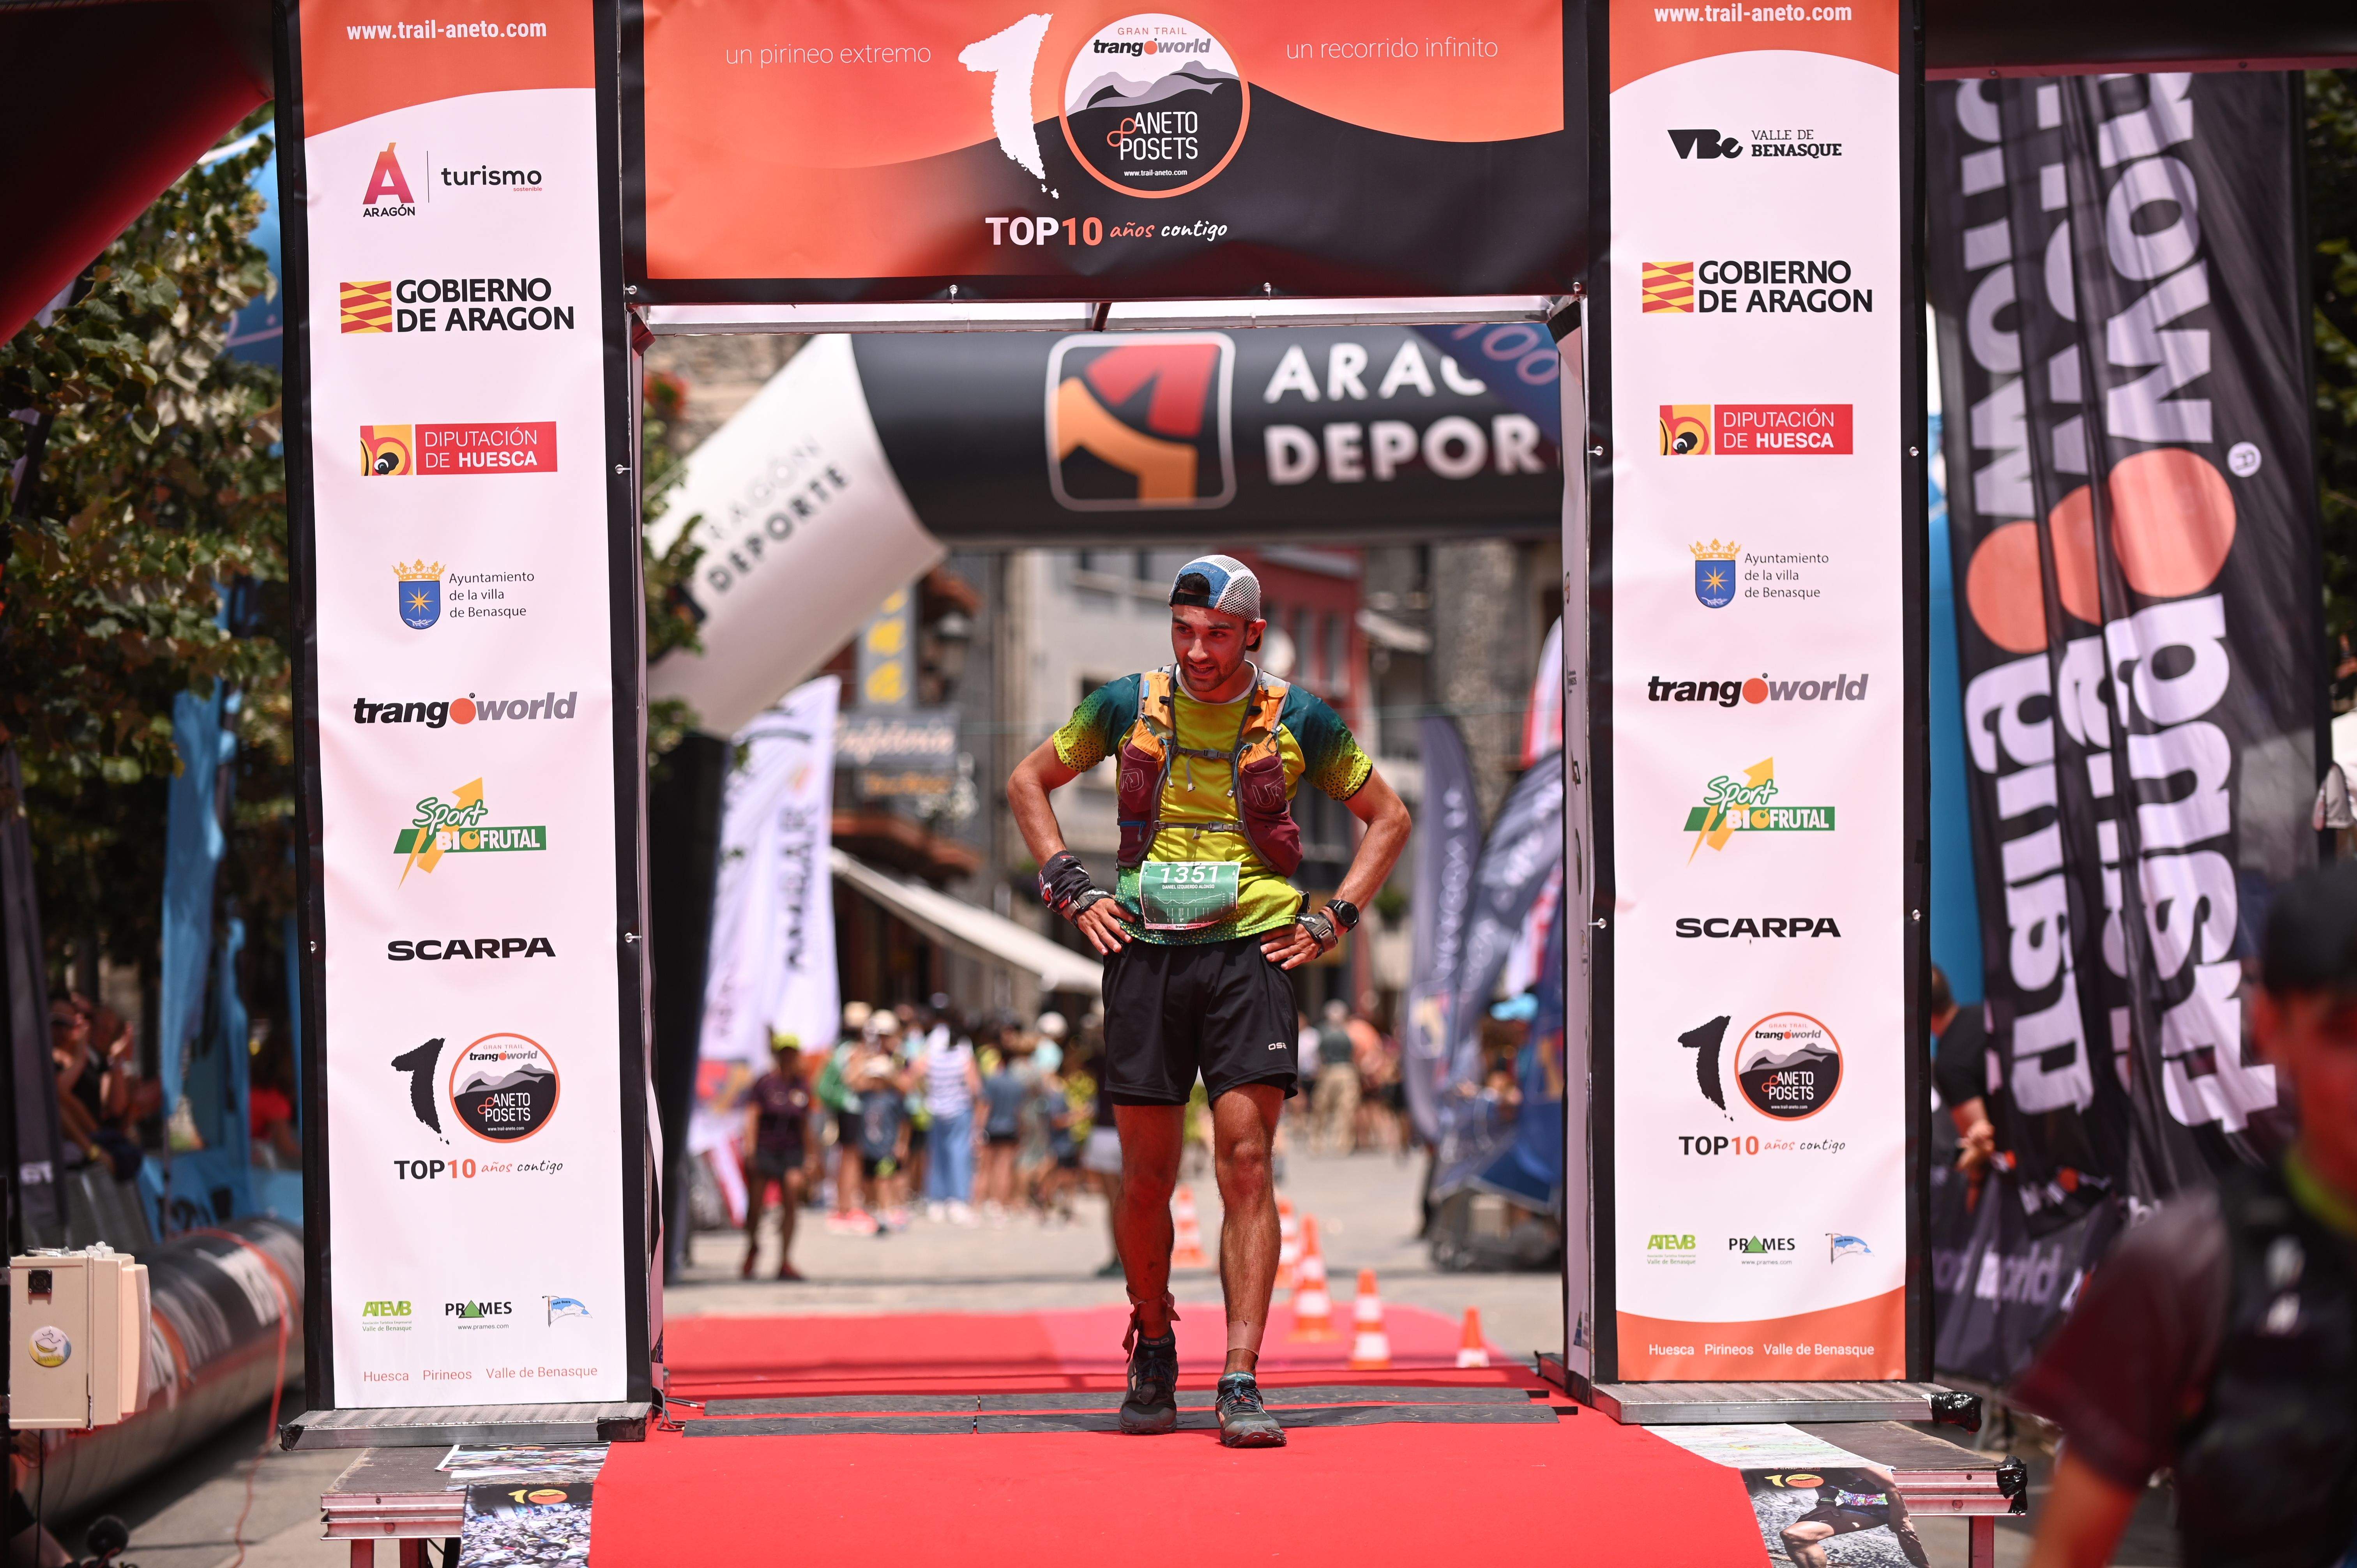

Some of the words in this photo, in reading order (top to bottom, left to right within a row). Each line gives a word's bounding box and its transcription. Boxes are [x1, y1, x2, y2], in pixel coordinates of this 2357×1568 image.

[1654, 3, 1852, 22] www.trail-aneto.com
[346, 19, 547, 41] www.trail-aneto.com
[1117, 27, 1149, 35] GRAN
[1155, 27, 1187, 35] TRAIL
[726, 48, 753, 65] un
[760, 43, 833, 69] pirineo
[839, 44, 931, 64] extremo
[1286, 43, 1313, 59] un
[1321, 37, 1419, 59] recorrido
[1425, 36, 1499, 58] infinito
[1134, 111, 1198, 135] ANETO
[1751, 129, 1792, 141] VALLE
[1797, 129, 1814, 140] DE
[1120, 136, 1198, 161] POSETS
[1751, 143, 1842, 159] BENASQUE
[441, 165, 542, 186] turismo
[362, 204, 415, 218] ARAGÓN
[1110, 221, 1156, 238] años
[1161, 220, 1228, 242] contigo
[1698, 260, 1851, 284] GOBIERNO
[396, 277, 551, 304] GOBIERNO
[1699, 289, 1737, 313] DE
[1746, 288, 1873, 313] ARAGON
[397, 308, 436, 332] DE
[445, 306, 574, 332] ARAGON
[1723, 408, 1834, 428] DIPUTACIÓN
[424, 427, 537, 447] DIPUTACIÓN
[1723, 433, 1748, 449] DE
[1756, 432, 1834, 449] HUESCA
[426, 452, 451, 468] DE
[458, 451, 538, 468] HUESCA
[706, 463, 850, 595] DEPORTE
[1744, 553, 1829, 567] Ayuntamiento
[449, 571, 535, 586] Ayuntamiento
[1744, 570, 1760, 581] de
[1763, 570, 1773, 581] la
[1776, 570, 1800, 581] villa
[449, 590, 464, 601] de
[467, 590, 478, 600] la
[481, 589, 505, 600] villa
[1744, 588, 1760, 598] de
[1763, 587, 1821, 600] Benasque
[449, 607, 465, 618] de
[468, 606, 527, 620] Benasque
[1703, 775, 1779, 814] Sport
[412, 796, 489, 836] Sport
[1726, 808, 1829, 829] BIOFRUTAL
[436, 829, 541, 851] BIOFRUTAL
[1160, 865, 1219, 884] 1351
[1675, 918, 1842, 938] SCARPA
[387, 937, 557, 961] SCARPA
[1777, 1071, 1814, 1086] ANETO
[493, 1092, 531, 1107] ANETO
[1769, 1086, 1814, 1100] POSETS
[485, 1107, 531, 1123] POSETS
[1764, 1138, 1795, 1151] años
[1800, 1139, 1846, 1154] contigo
[481, 1162, 512, 1173] años
[517, 1160, 563, 1175] contigo
[1647, 1234, 1696, 1250] ATEVB
[362, 1300, 412, 1317] ATEVB
[1648, 1344, 1695, 1356] Huesca
[1705, 1343, 1754, 1356] Pirineos
[1763, 1343, 1793, 1355] Valle
[1796, 1343, 1811, 1355] de
[1814, 1343, 1875, 1358] Benasque
[363, 1371, 409, 1382] Huesca
[423, 1369, 472, 1381] Pirineos
[486, 1368, 516, 1379] Valle
[520, 1367, 534, 1378] de
[538, 1366, 598, 1379] Benasque
